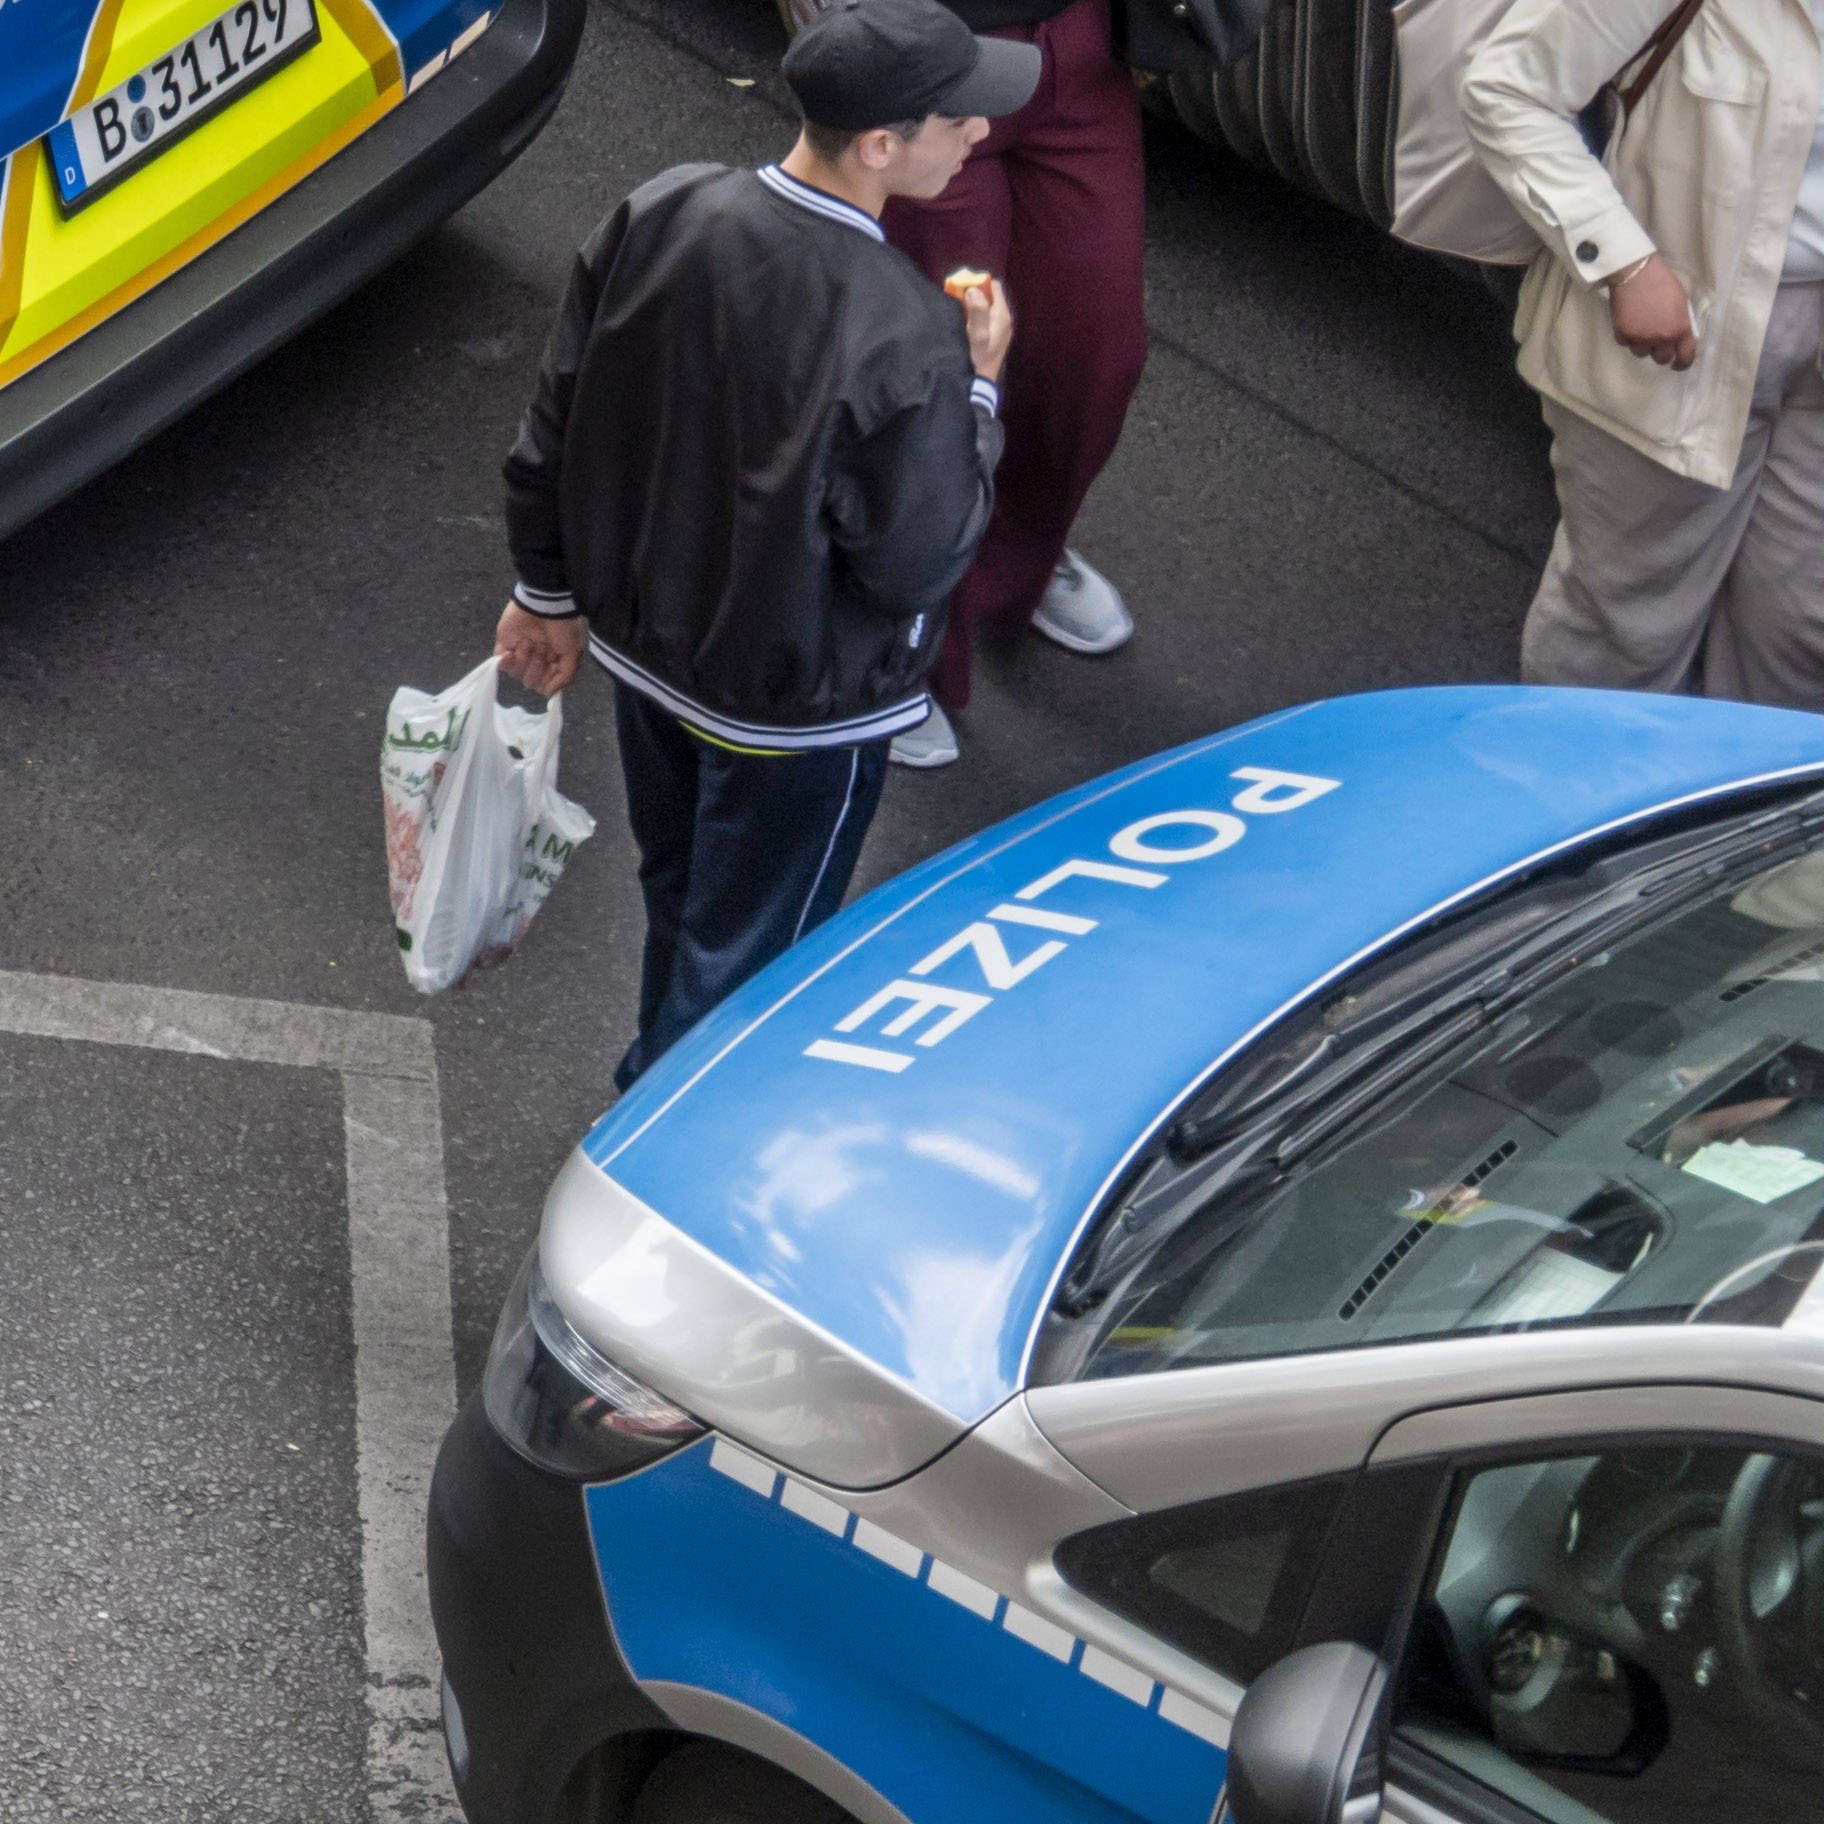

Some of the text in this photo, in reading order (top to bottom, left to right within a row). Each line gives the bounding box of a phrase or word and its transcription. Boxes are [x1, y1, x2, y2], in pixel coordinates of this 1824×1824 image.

[93, 97, 127, 163] B
[64, 165, 77, 186] D
[801, 765, 1345, 1074] POLIZEI
